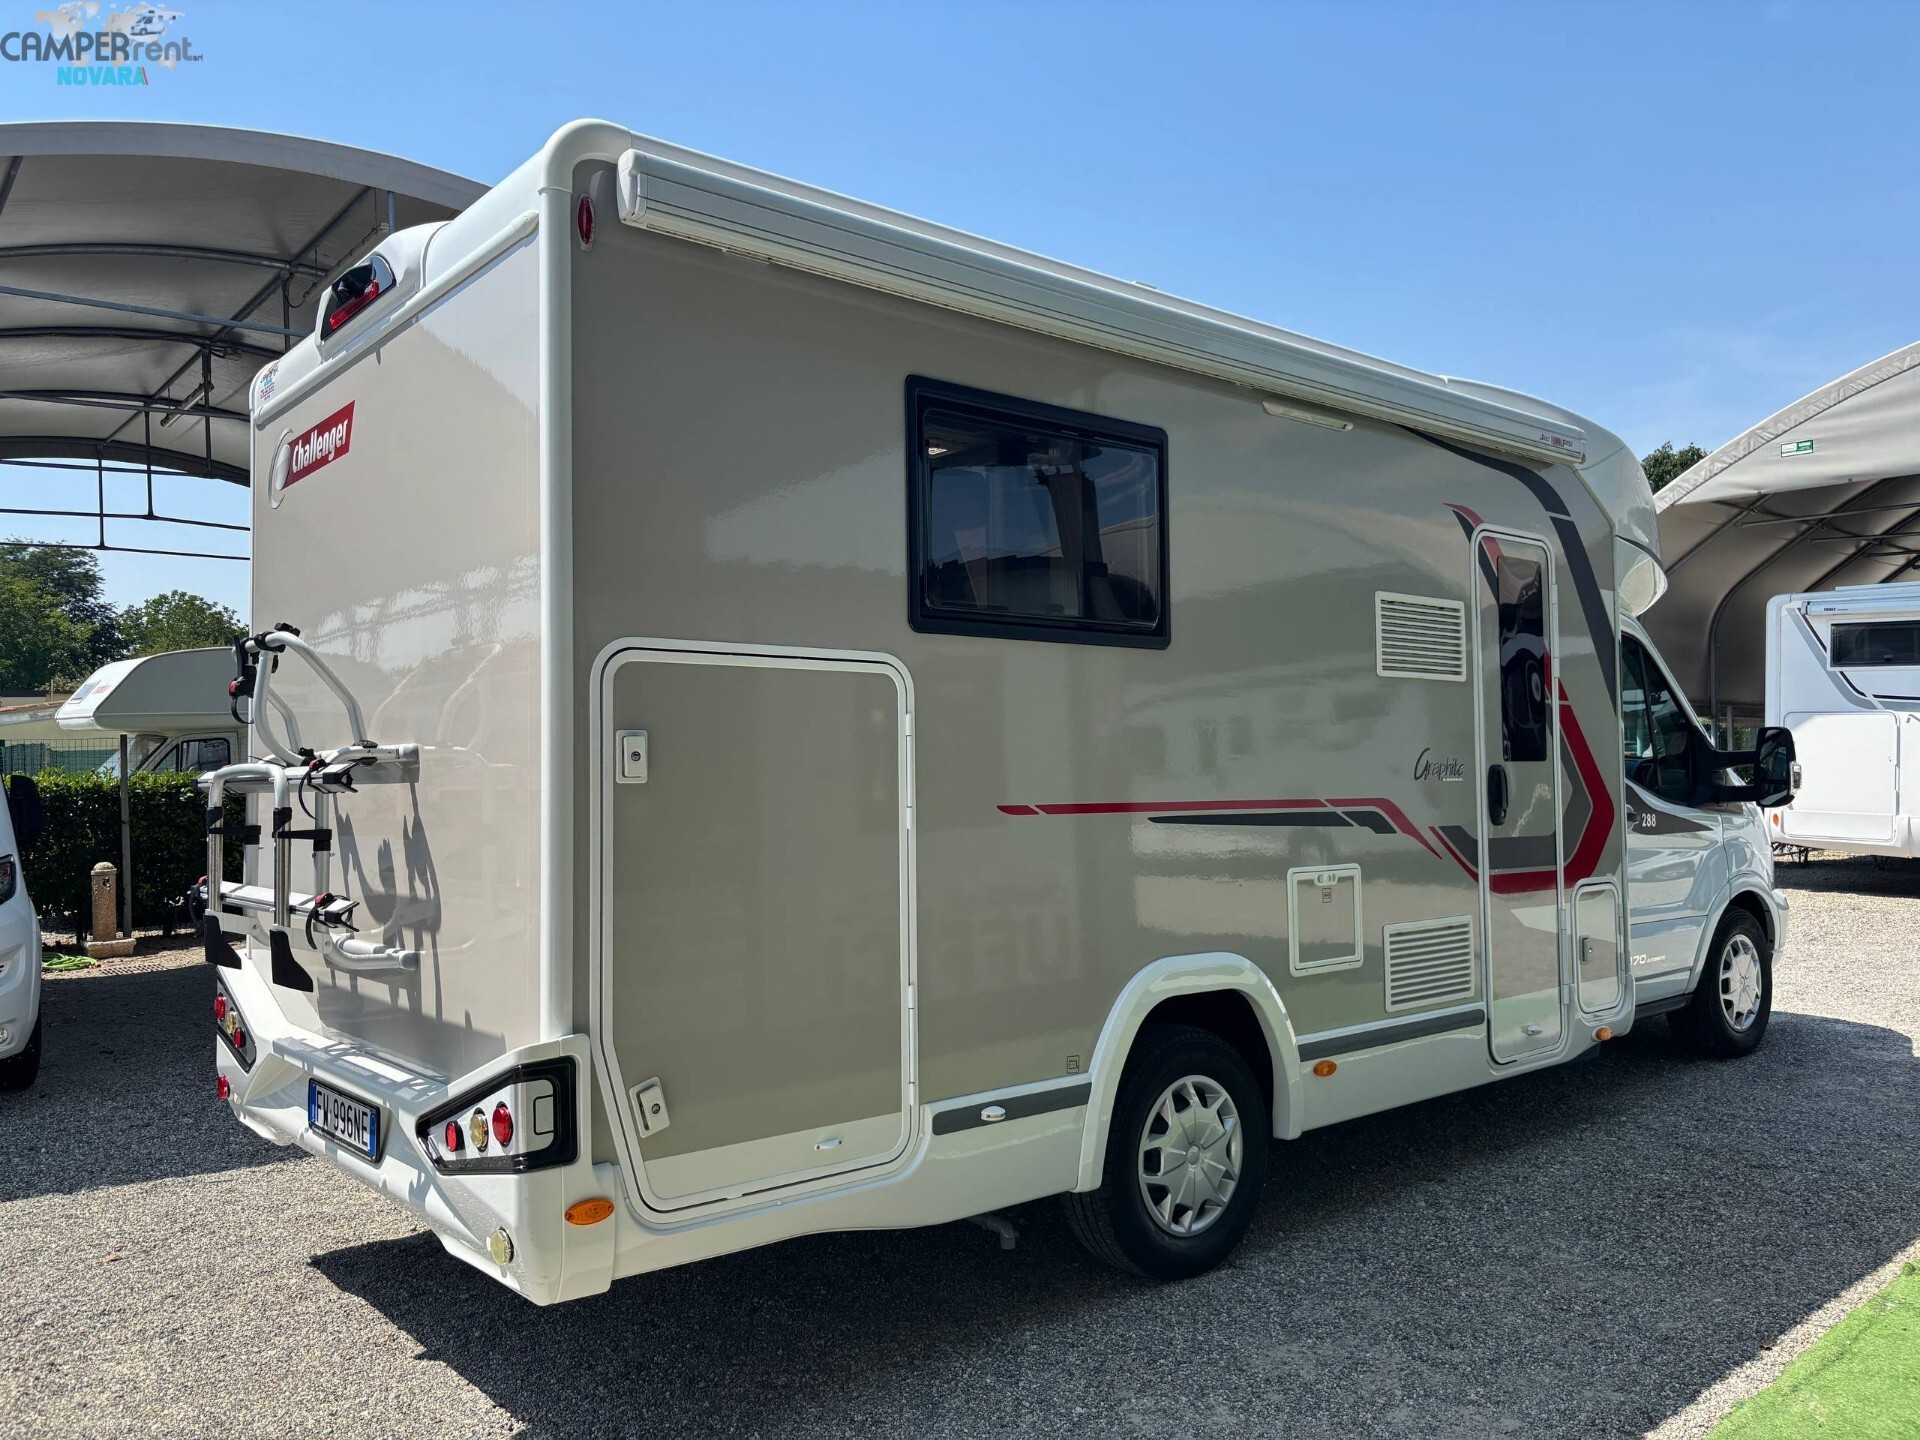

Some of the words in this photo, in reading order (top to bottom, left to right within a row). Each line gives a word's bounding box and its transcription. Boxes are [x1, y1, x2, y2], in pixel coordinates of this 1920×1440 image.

[292, 418, 349, 474] Challenger
[1413, 747, 1465, 781] Graphite
[1641, 813, 1657, 827] 288
[333, 1097, 369, 1147] 996NE
